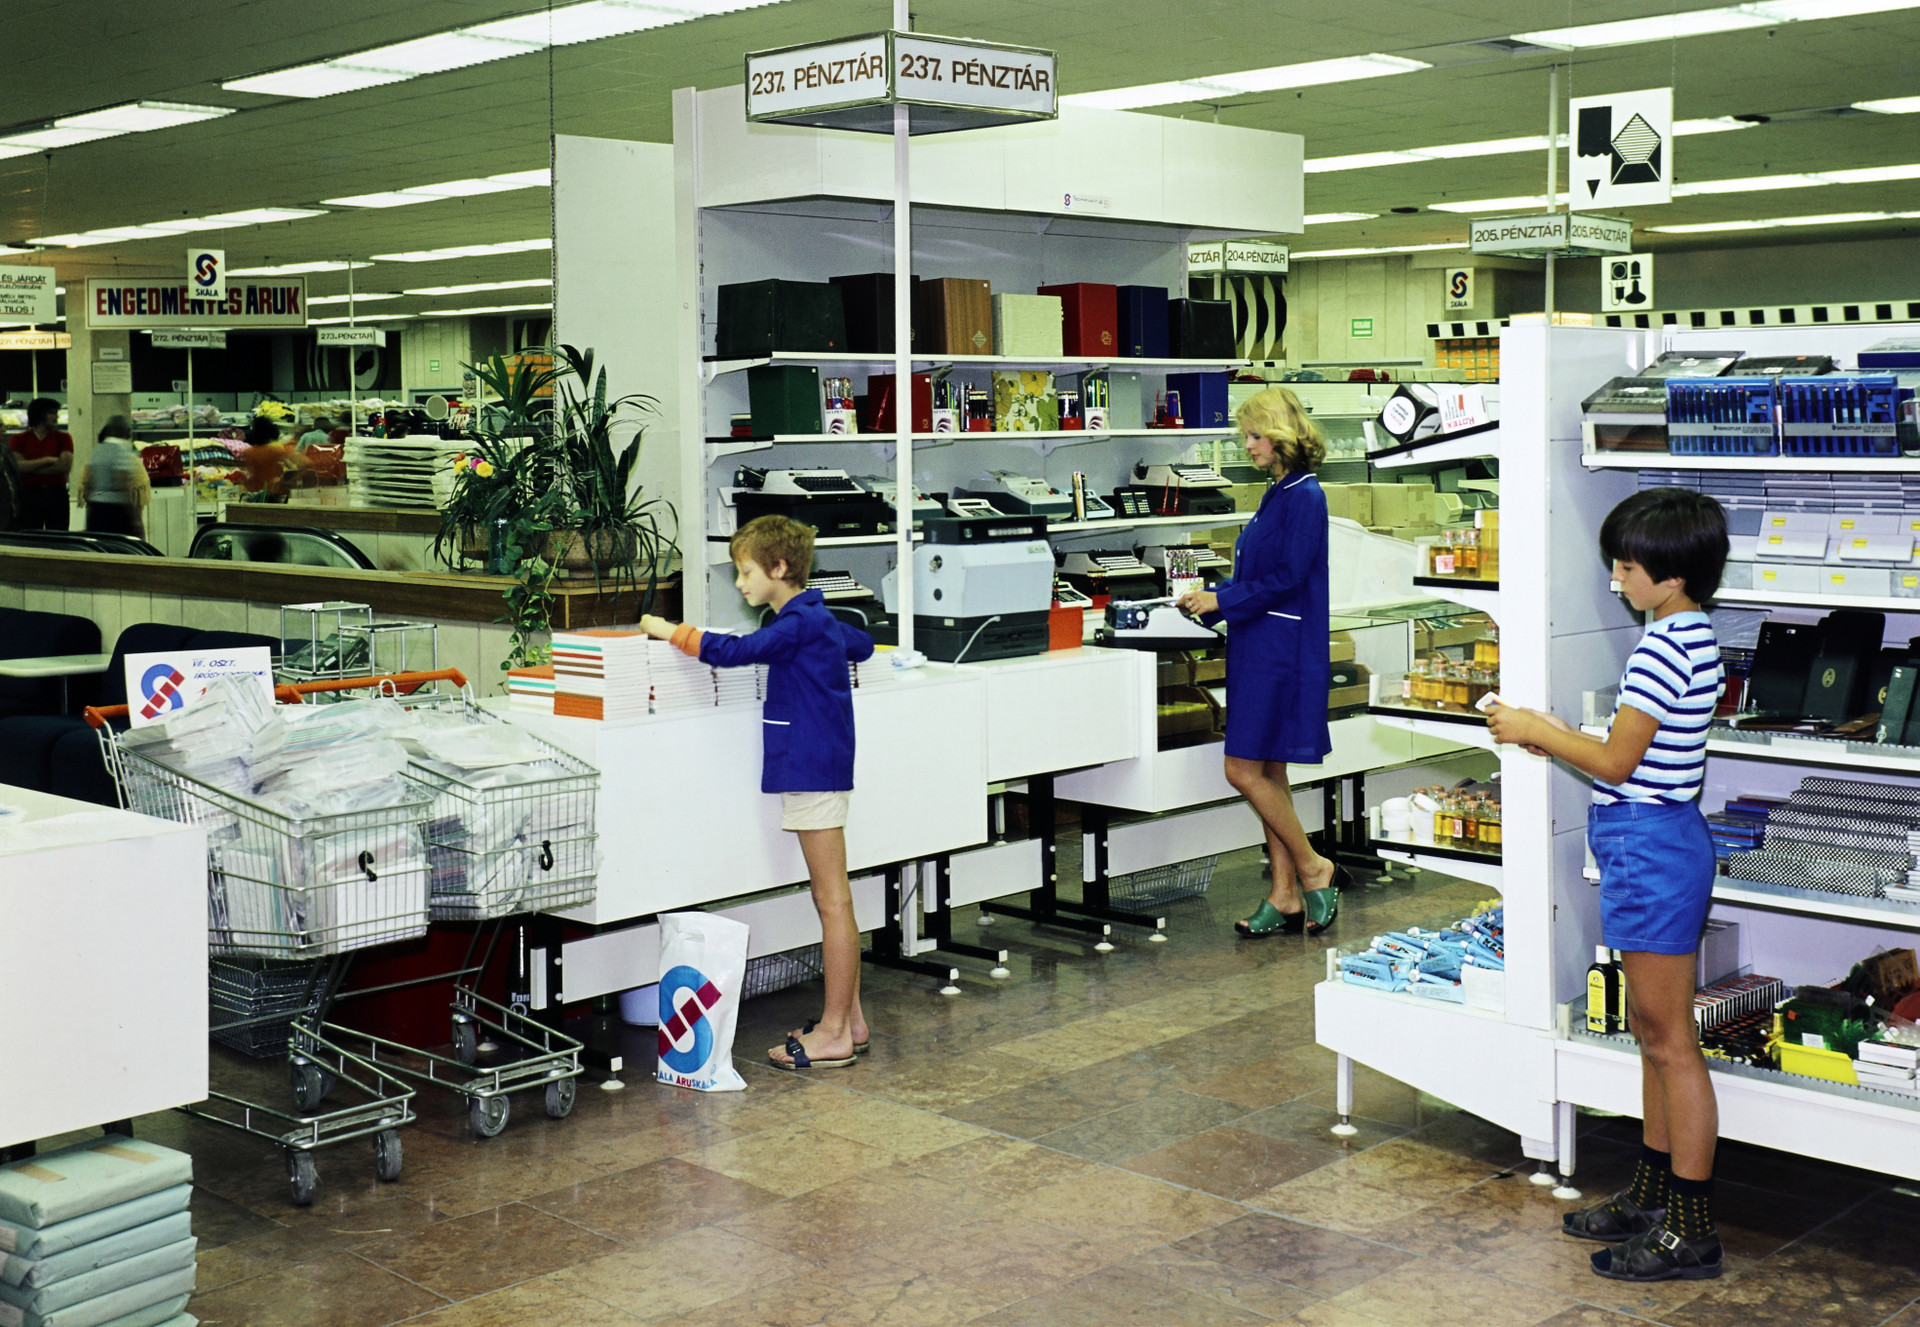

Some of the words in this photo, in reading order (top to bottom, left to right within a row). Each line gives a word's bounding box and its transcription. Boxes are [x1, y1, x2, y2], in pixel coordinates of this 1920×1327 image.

[752, 71, 785, 96] 237.
[794, 51, 883, 91] PÉNZTÁR
[900, 53, 943, 81] 237.
[952, 58, 1050, 93] PÉNZTÁR
[195, 287, 219, 297] SKÁLA
[245, 285, 300, 315] ÁRUK
